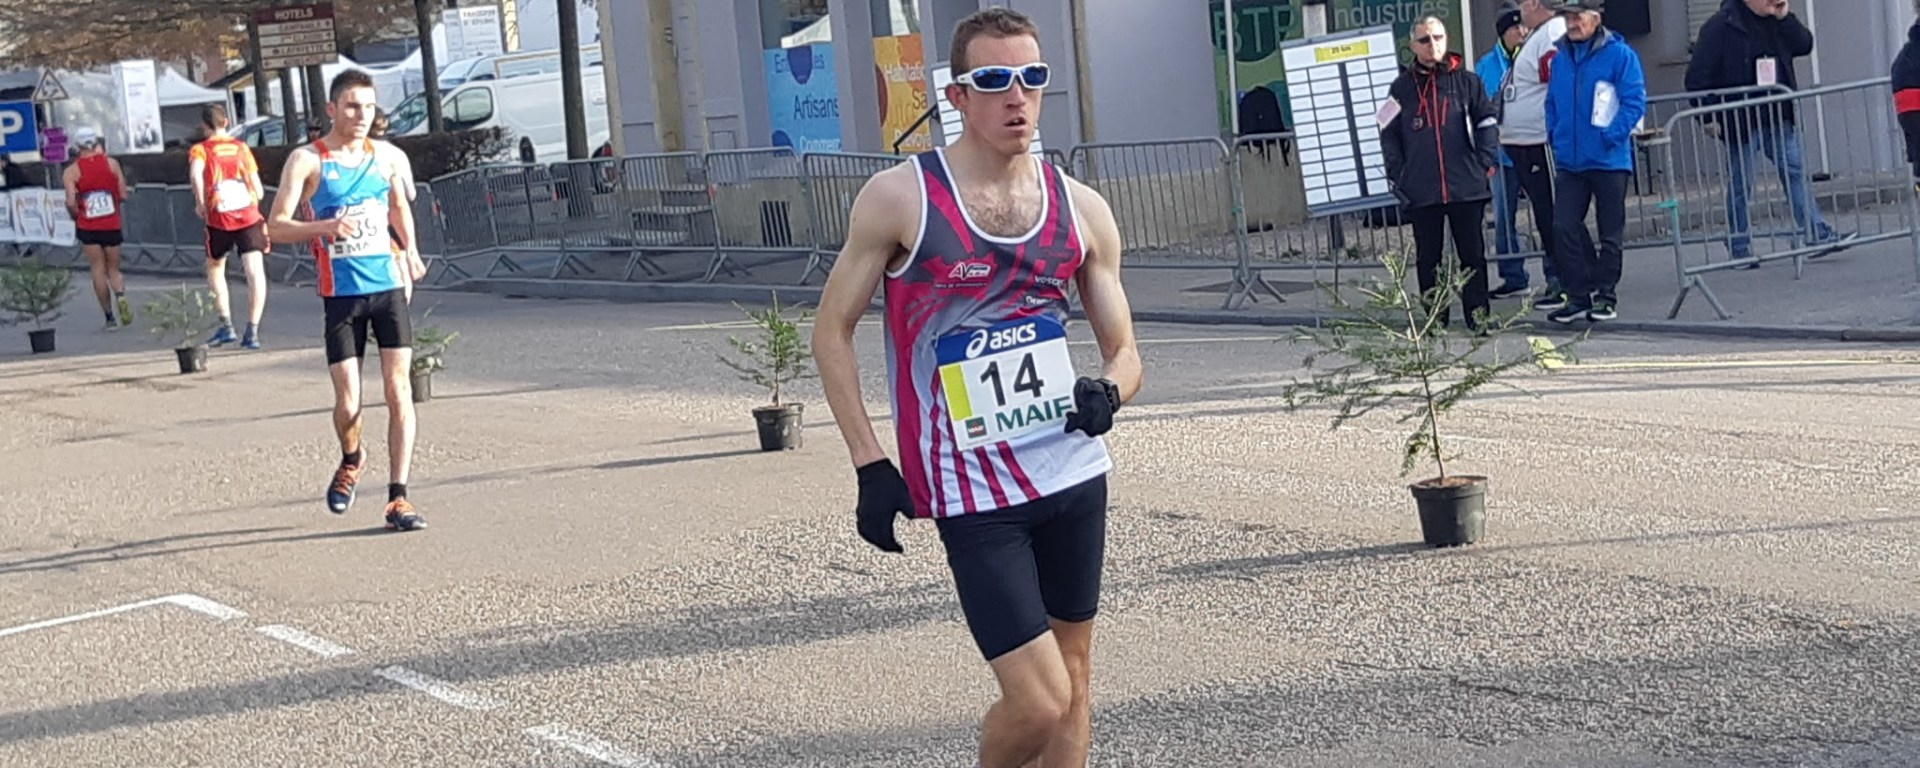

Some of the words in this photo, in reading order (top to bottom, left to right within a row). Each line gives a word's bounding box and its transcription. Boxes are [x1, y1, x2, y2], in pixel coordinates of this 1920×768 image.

[275, 7, 314, 20] HOTELS
[1213, 4, 1295, 56] BTP
[1333, 0, 1450, 30] ndustries
[793, 94, 840, 120] Artisans
[0, 110, 23, 147] P
[989, 323, 1037, 349] asics
[979, 351, 1045, 408] 14
[994, 395, 1073, 433] MAIF
